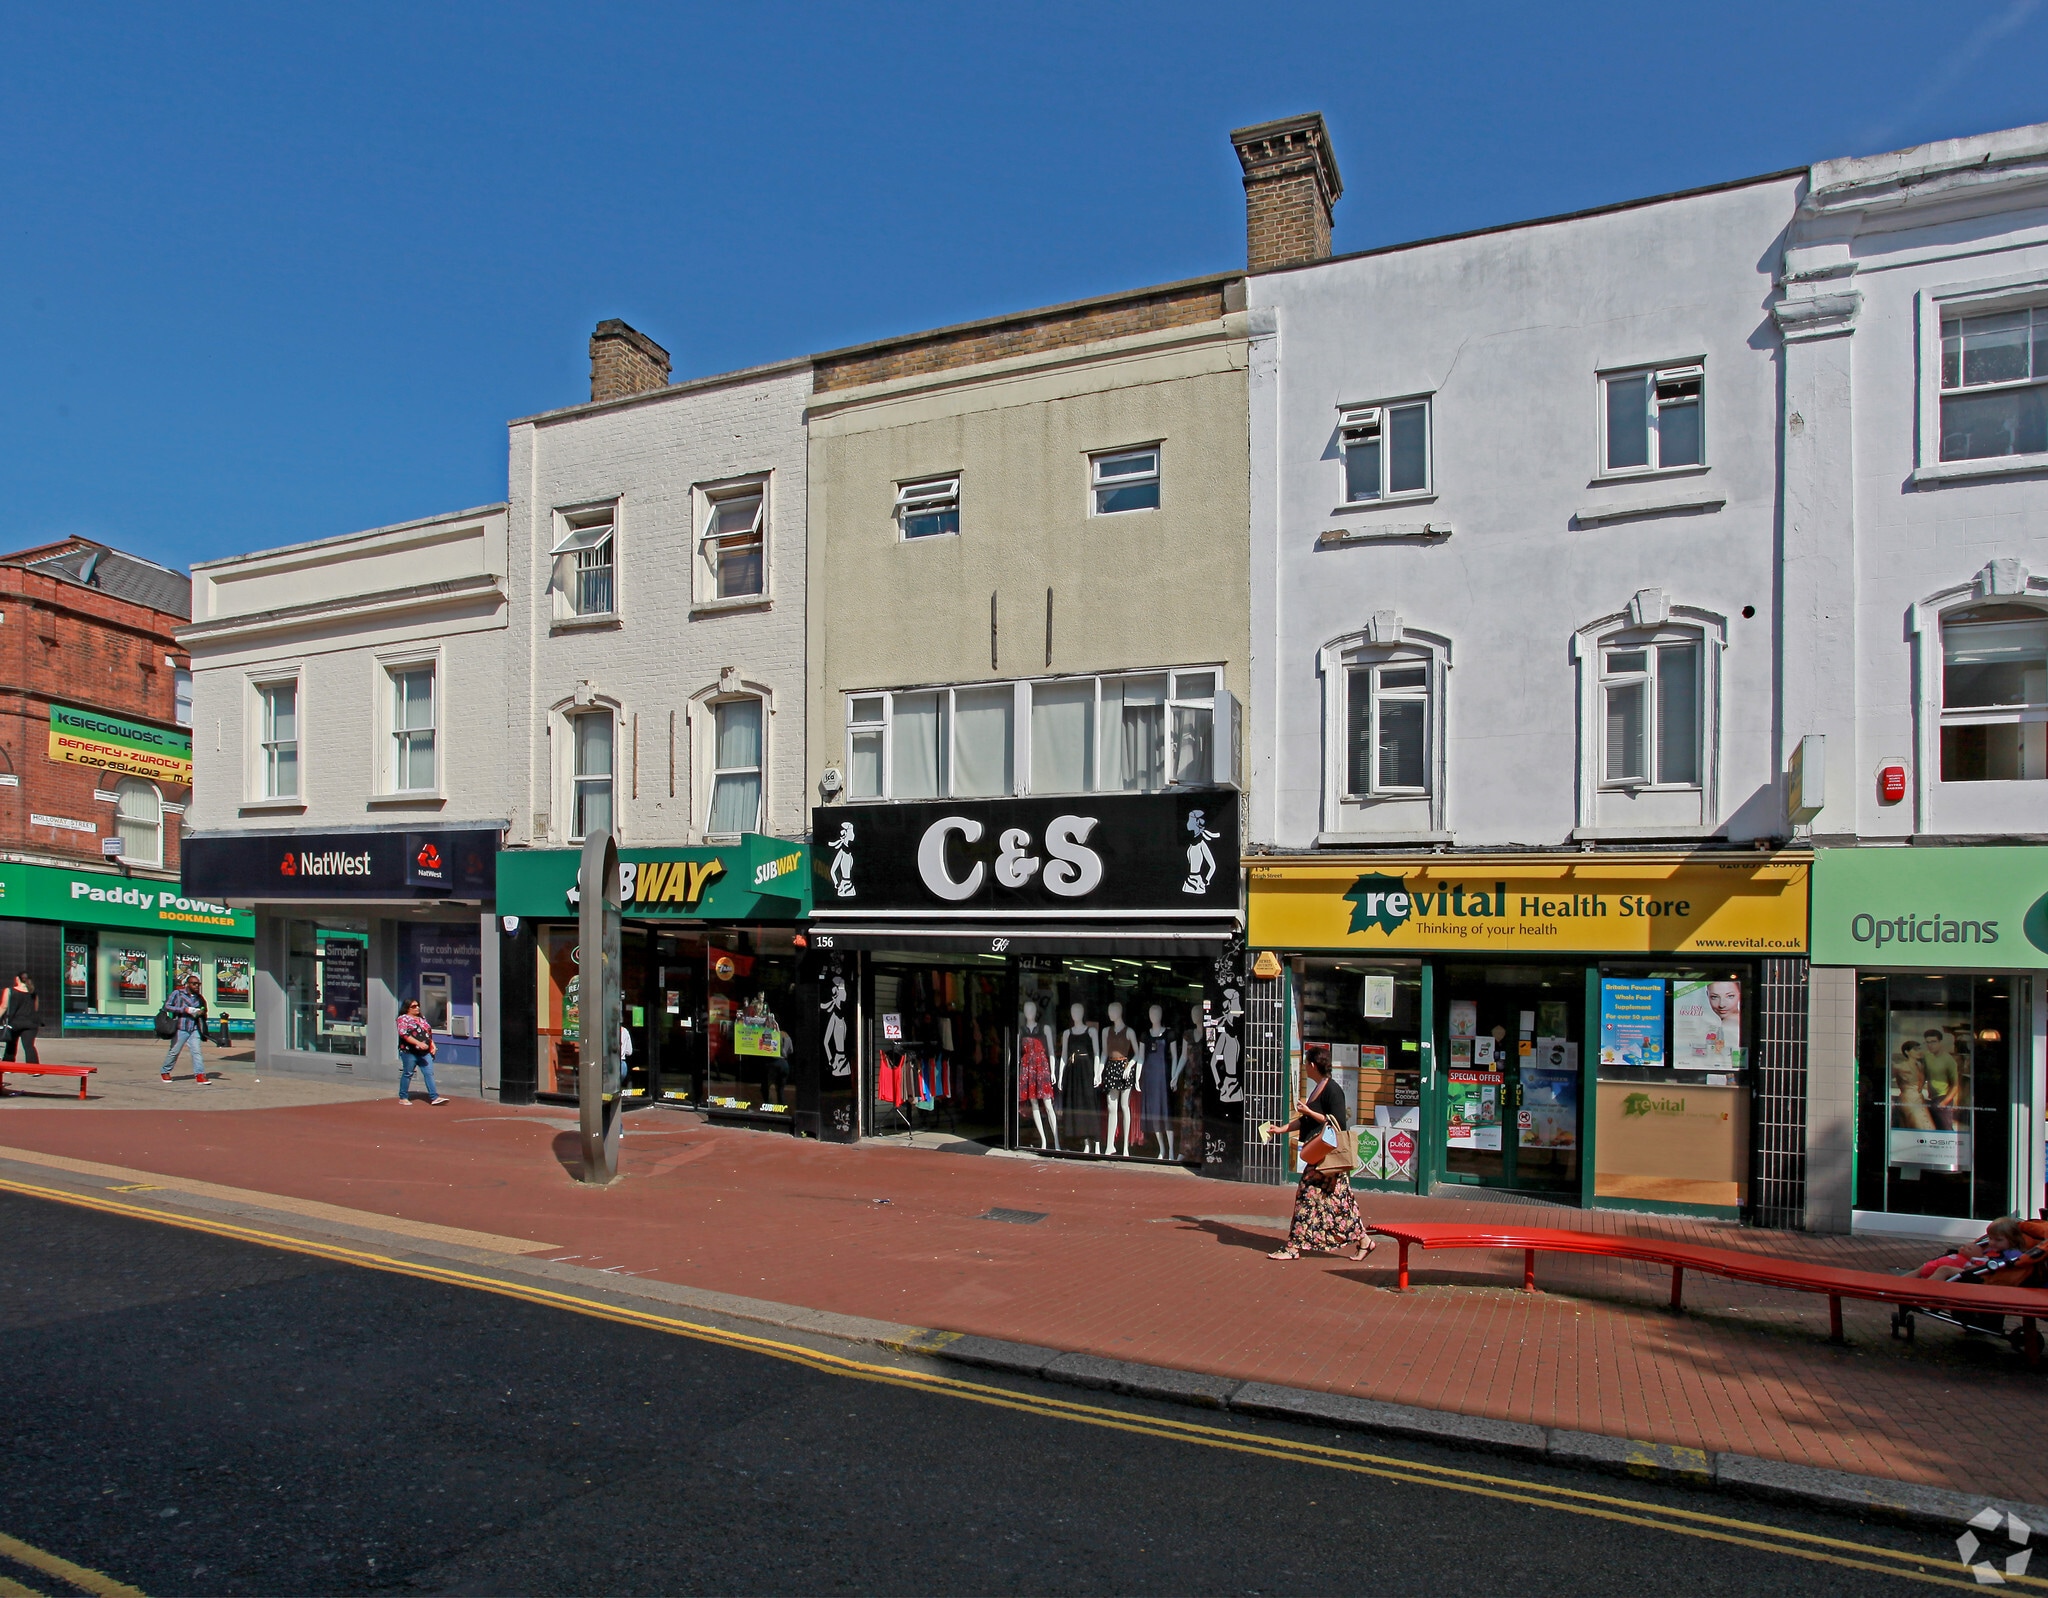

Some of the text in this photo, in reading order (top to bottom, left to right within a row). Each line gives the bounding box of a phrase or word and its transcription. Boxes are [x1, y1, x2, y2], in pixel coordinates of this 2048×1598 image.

[80, 755, 106, 767] 020
[138, 767, 160, 778] 1013
[130, 752, 180, 769] ZWROTY
[32, 815, 67, 825] HOLLOWAY
[70, 820, 93, 829] STREET
[301, 851, 371, 875] NatWest
[754, 851, 802, 885] SUBWAY
[418, 869, 442, 878] NatWest
[71, 881, 154, 910] Paddy
[1367, 881, 1690, 917] revital Health Store
[159, 911, 235, 927] BOOKMAKER
[1416, 921, 1557, 939] Thinking of your health
[1851, 913, 1999, 948] Opticians
[816, 936, 834, 948] 156
[1696, 938, 1801, 948] www.revital.co.uk
[66, 945, 85, 954] £500
[127, 950, 146, 958] £500
[326, 944, 359, 959] Simpler
[420, 944, 435, 953] Free
[436, 944, 452, 954] cash
[182, 954, 200, 962] £500
[217, 956, 249, 965] WIN £500
[886, 1025, 900, 1035] £2
[1450, 1072, 1501, 1082] SPECIAL OFFER
[621, 1088, 645, 1097] SUBWAY
[663, 1091, 688, 1100] SUBWAY
[760, 1103, 788, 1113] SUBWAY
[1635, 1097, 1685, 1112] revital
